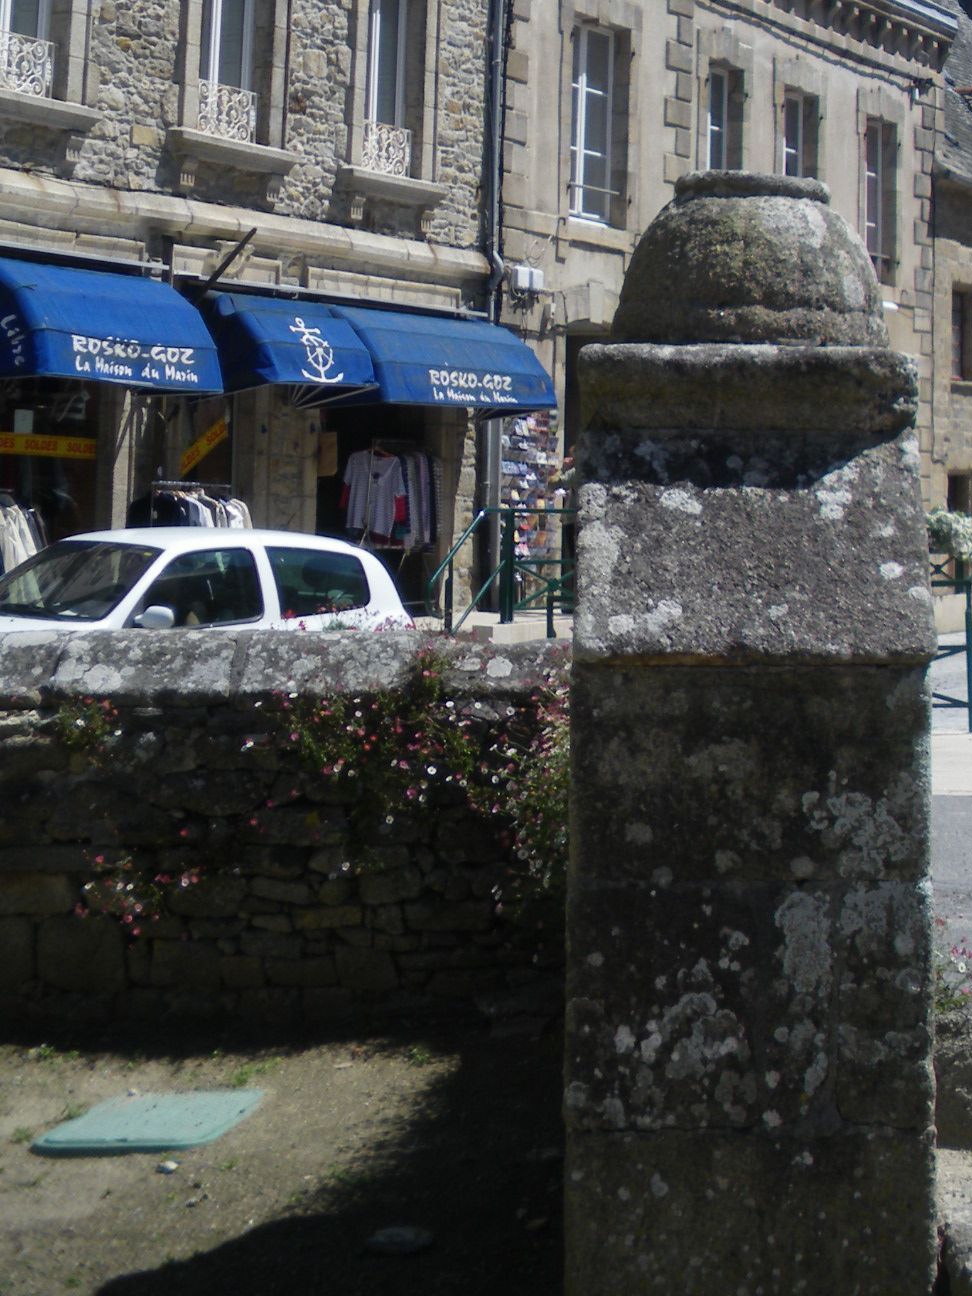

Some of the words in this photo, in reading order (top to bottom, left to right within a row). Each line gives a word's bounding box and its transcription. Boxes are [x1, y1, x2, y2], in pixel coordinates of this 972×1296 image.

[71, 334, 195, 364] ROSKO-GOZ
[75, 355, 90, 372] La
[95, 356, 133, 377] Maison
[141, 363, 160, 380] du
[165, 364, 199, 383] Marin
[428, 368, 512, 391] ROSKO-GOZ
[433, 386, 444, 401] La
[446, 387, 476, 402] Maison
[480, 391, 491, 403] du
[493, 391, 519, 404] Marin
